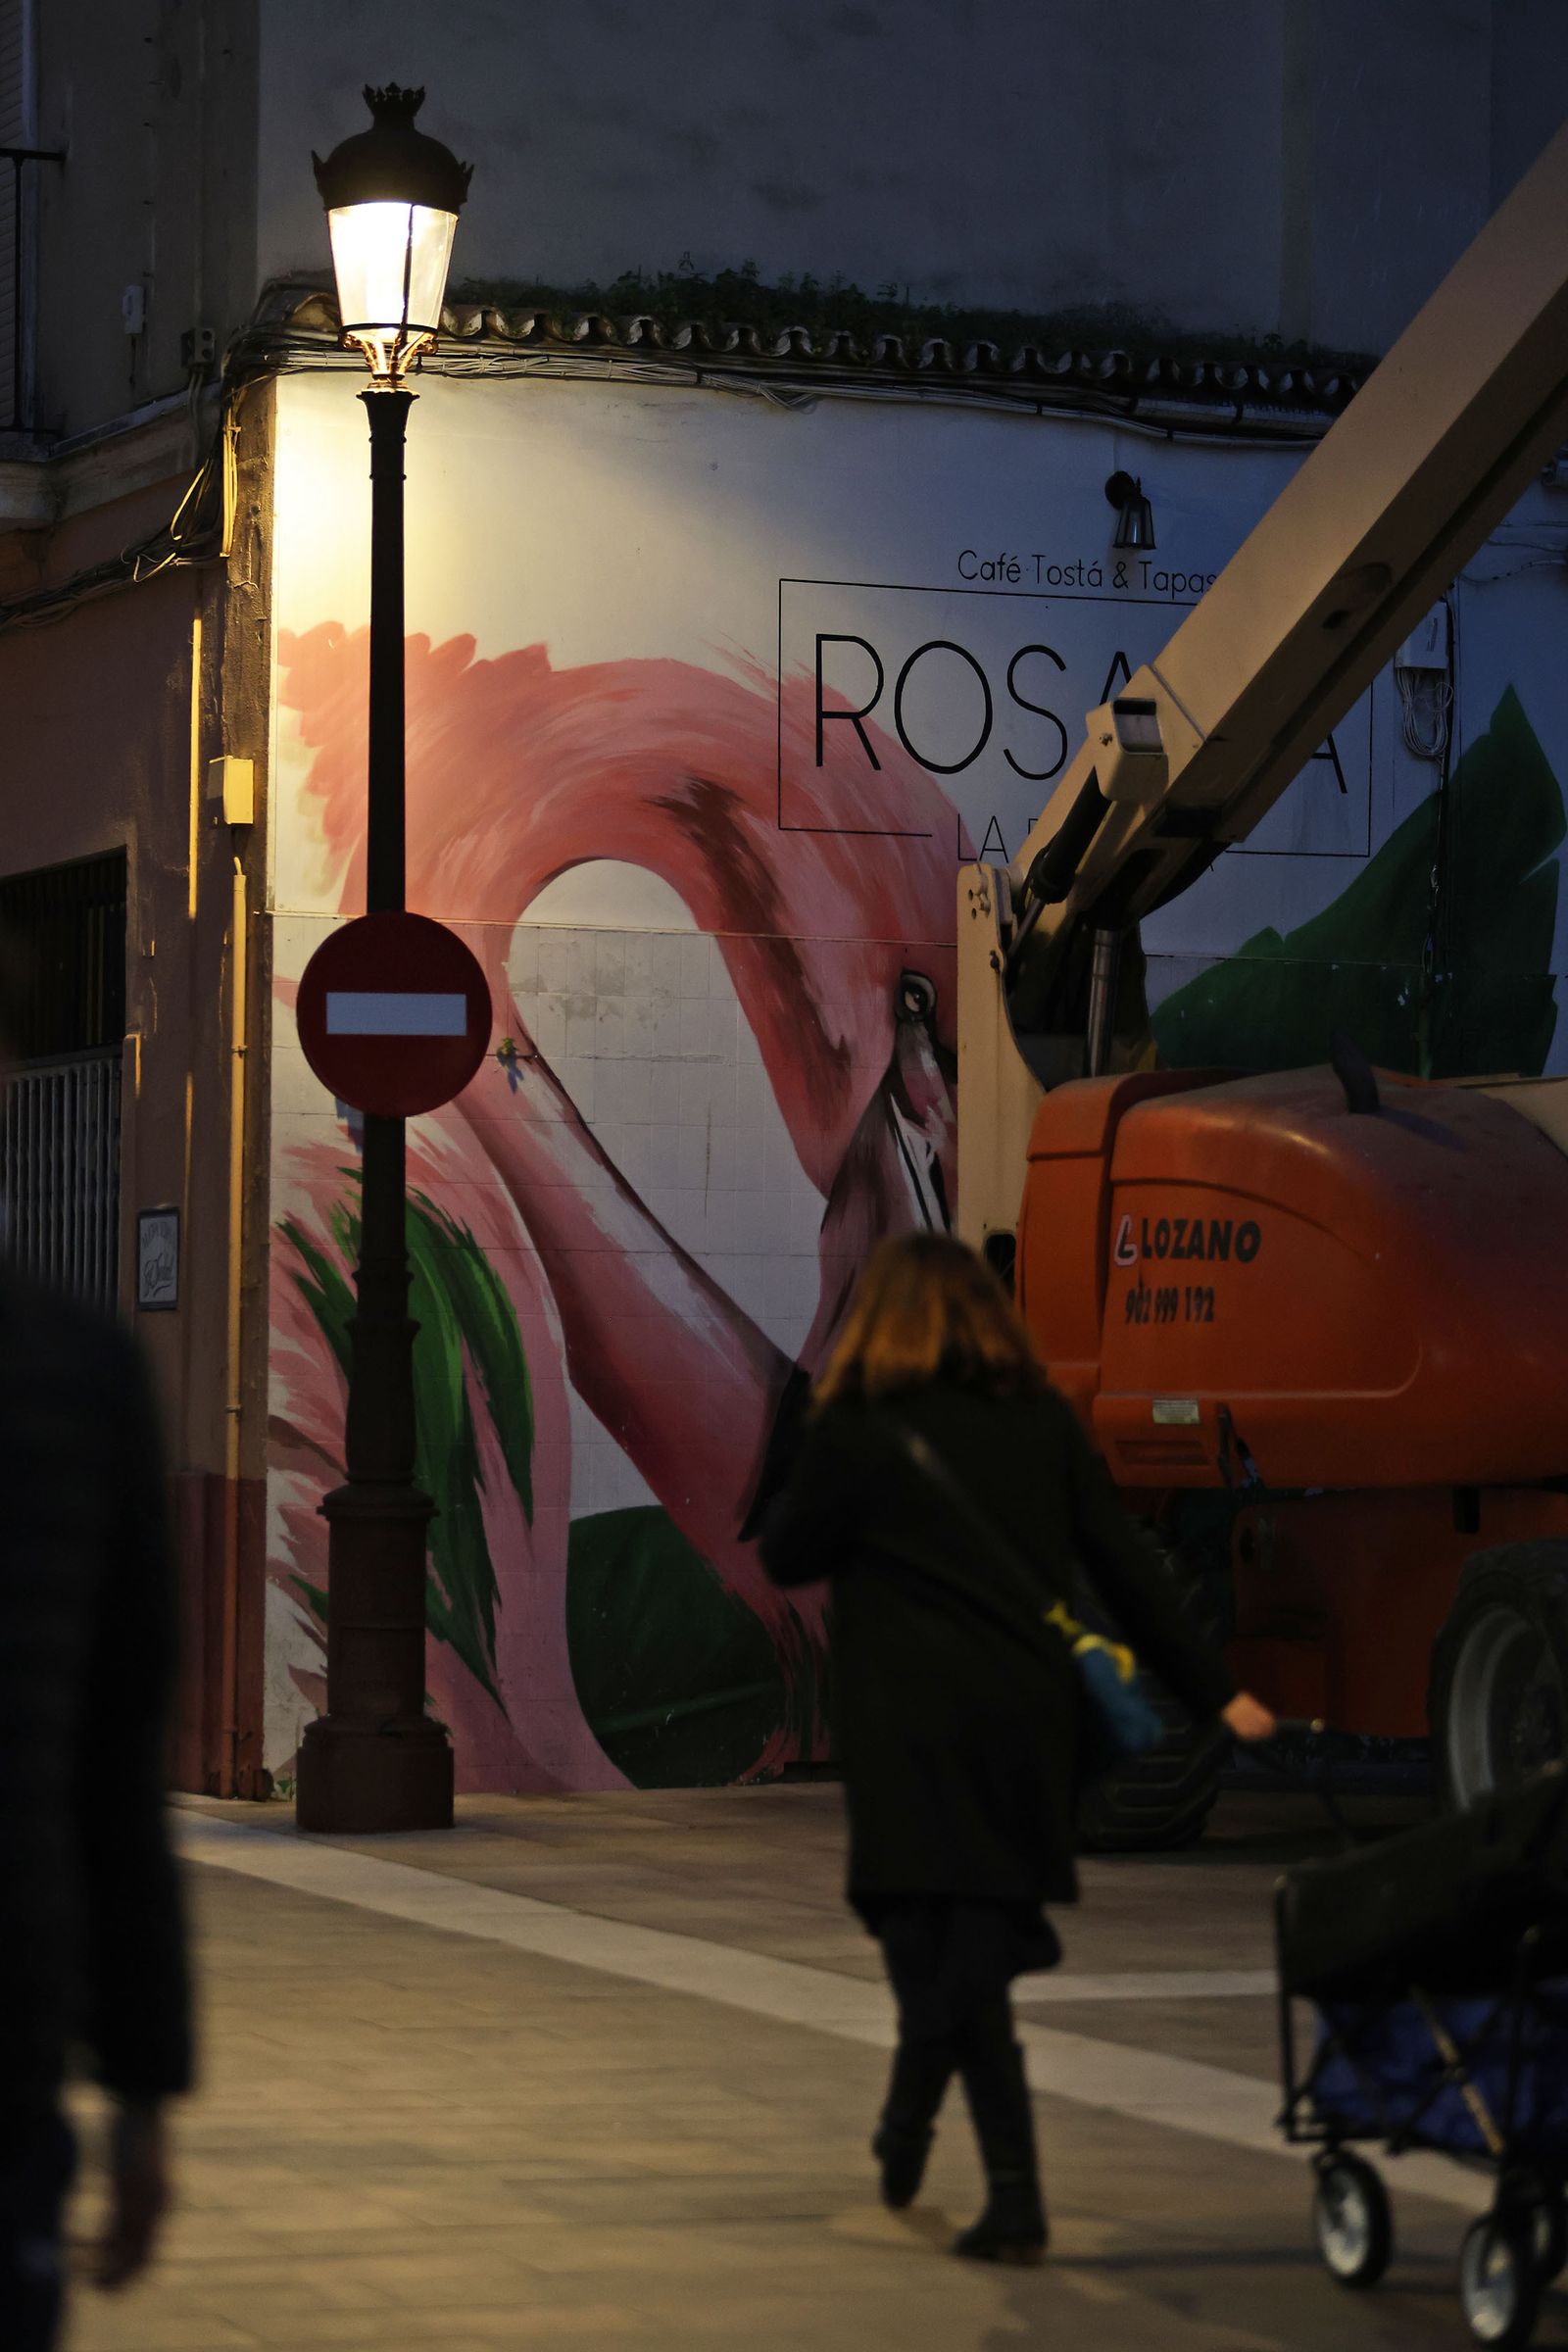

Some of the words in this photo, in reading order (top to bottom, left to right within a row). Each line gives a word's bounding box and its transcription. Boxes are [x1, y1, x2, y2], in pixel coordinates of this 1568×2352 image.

[957, 549, 1021, 583] Café
[1031, 555, 1102, 588] Tostá
[1111, 561, 1129, 589] &
[957, 813, 1009, 863] LA
[1142, 1217, 1262, 1263] LOZANO
